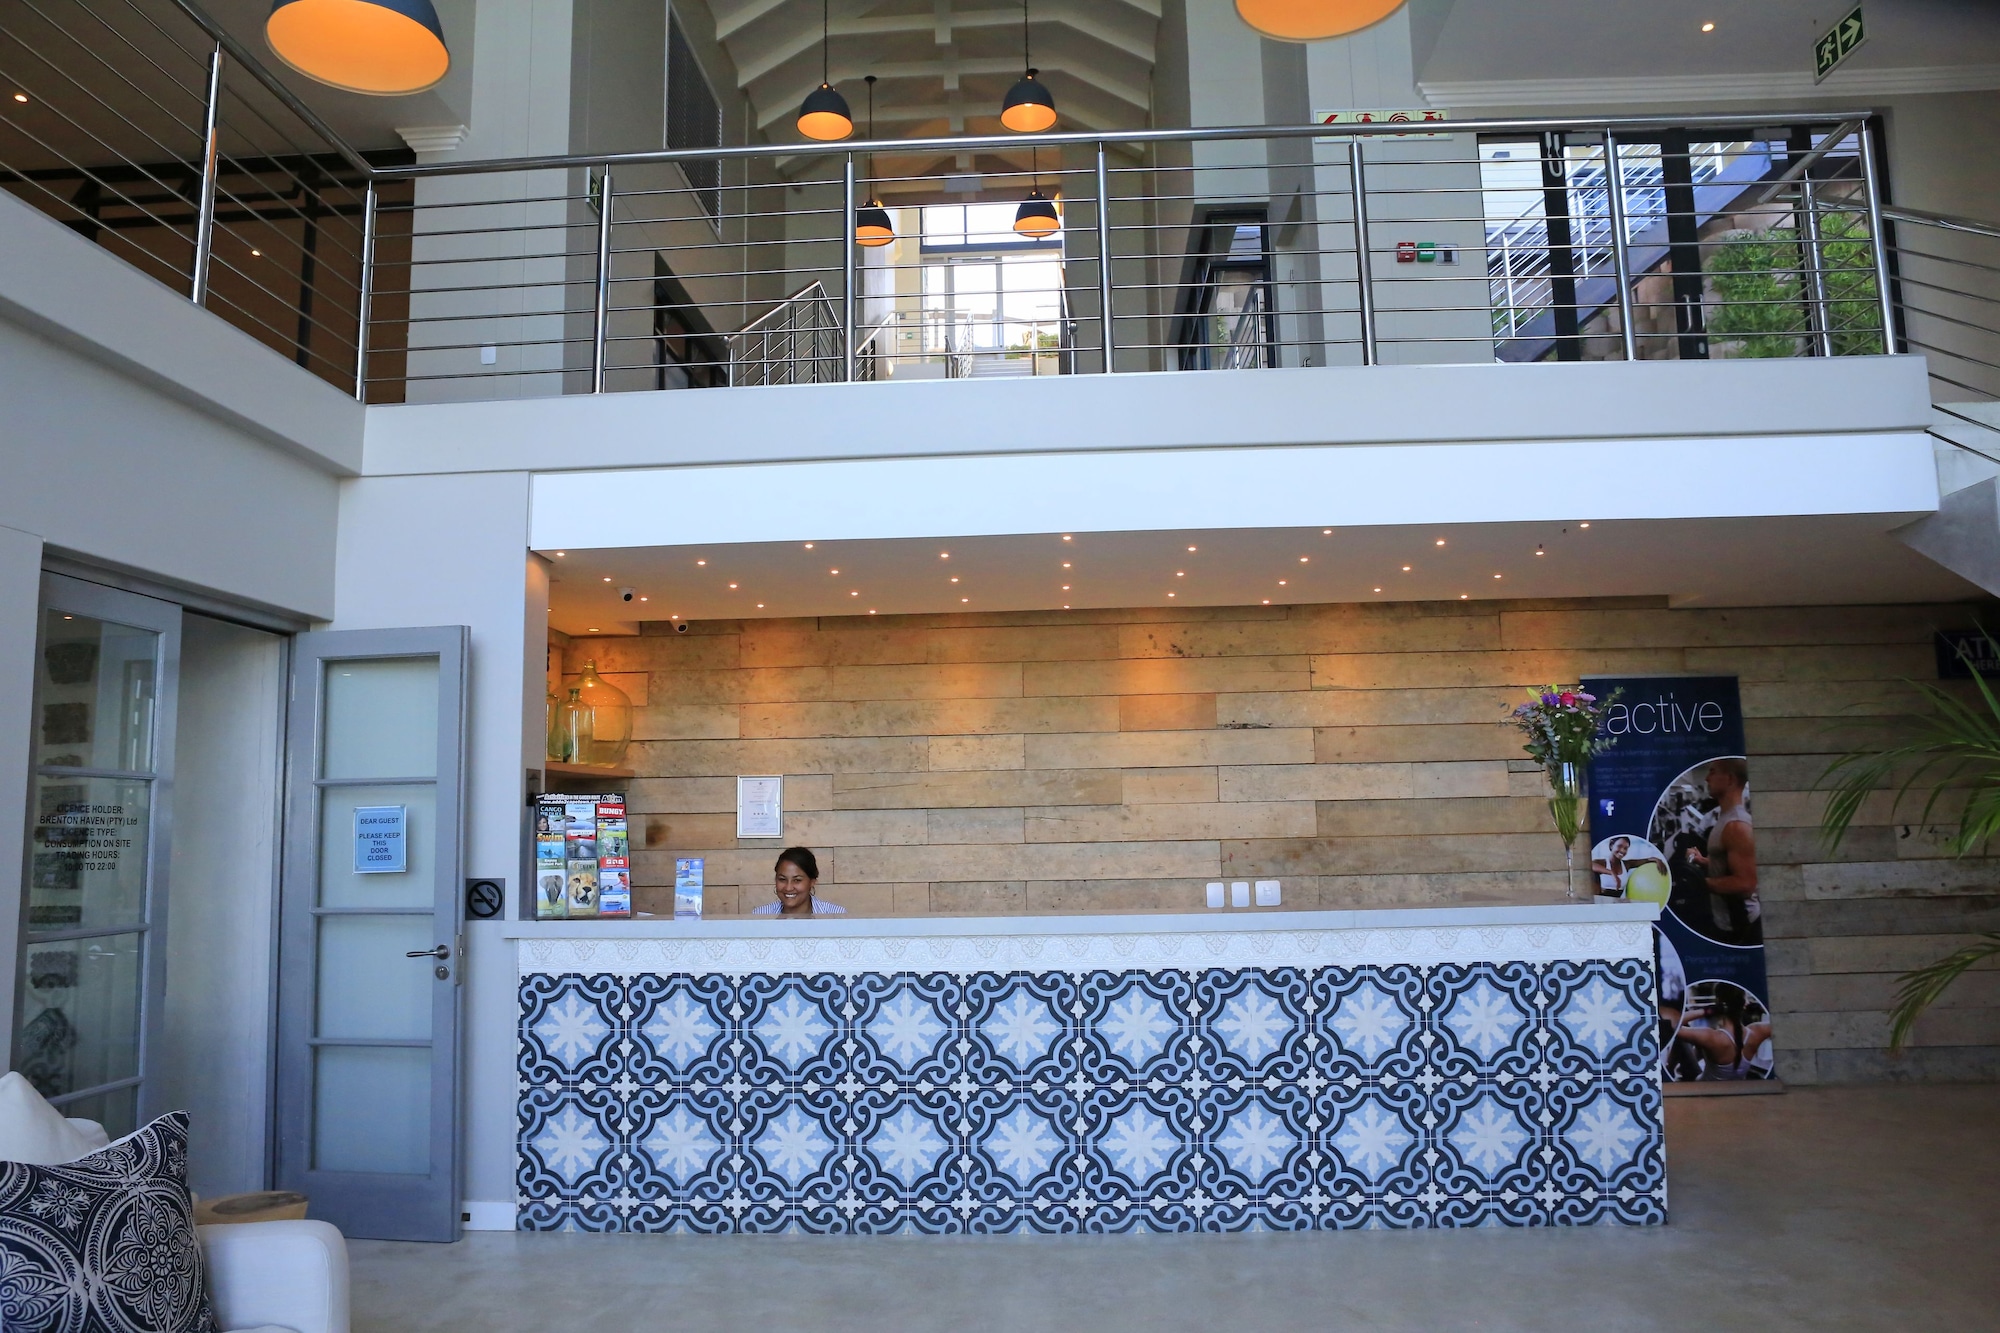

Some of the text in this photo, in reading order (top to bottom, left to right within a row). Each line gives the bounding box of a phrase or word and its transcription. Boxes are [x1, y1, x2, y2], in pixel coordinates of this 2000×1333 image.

[1606, 692, 1724, 735] active
[57, 805, 124, 814] LICENCE HOLDER:
[598, 807, 624, 815] BUNGY
[40, 815, 138, 827] BRENTON HAVEN (PTY) Ltd
[61, 828, 118, 836] LICENCE TYPE:
[537, 832, 563, 842] Swim
[44, 839, 131, 848] CONSUMPTION ON SITE
[56, 850, 120, 859] TRADING HOURS:
[97, 862, 116, 870] 22:00
